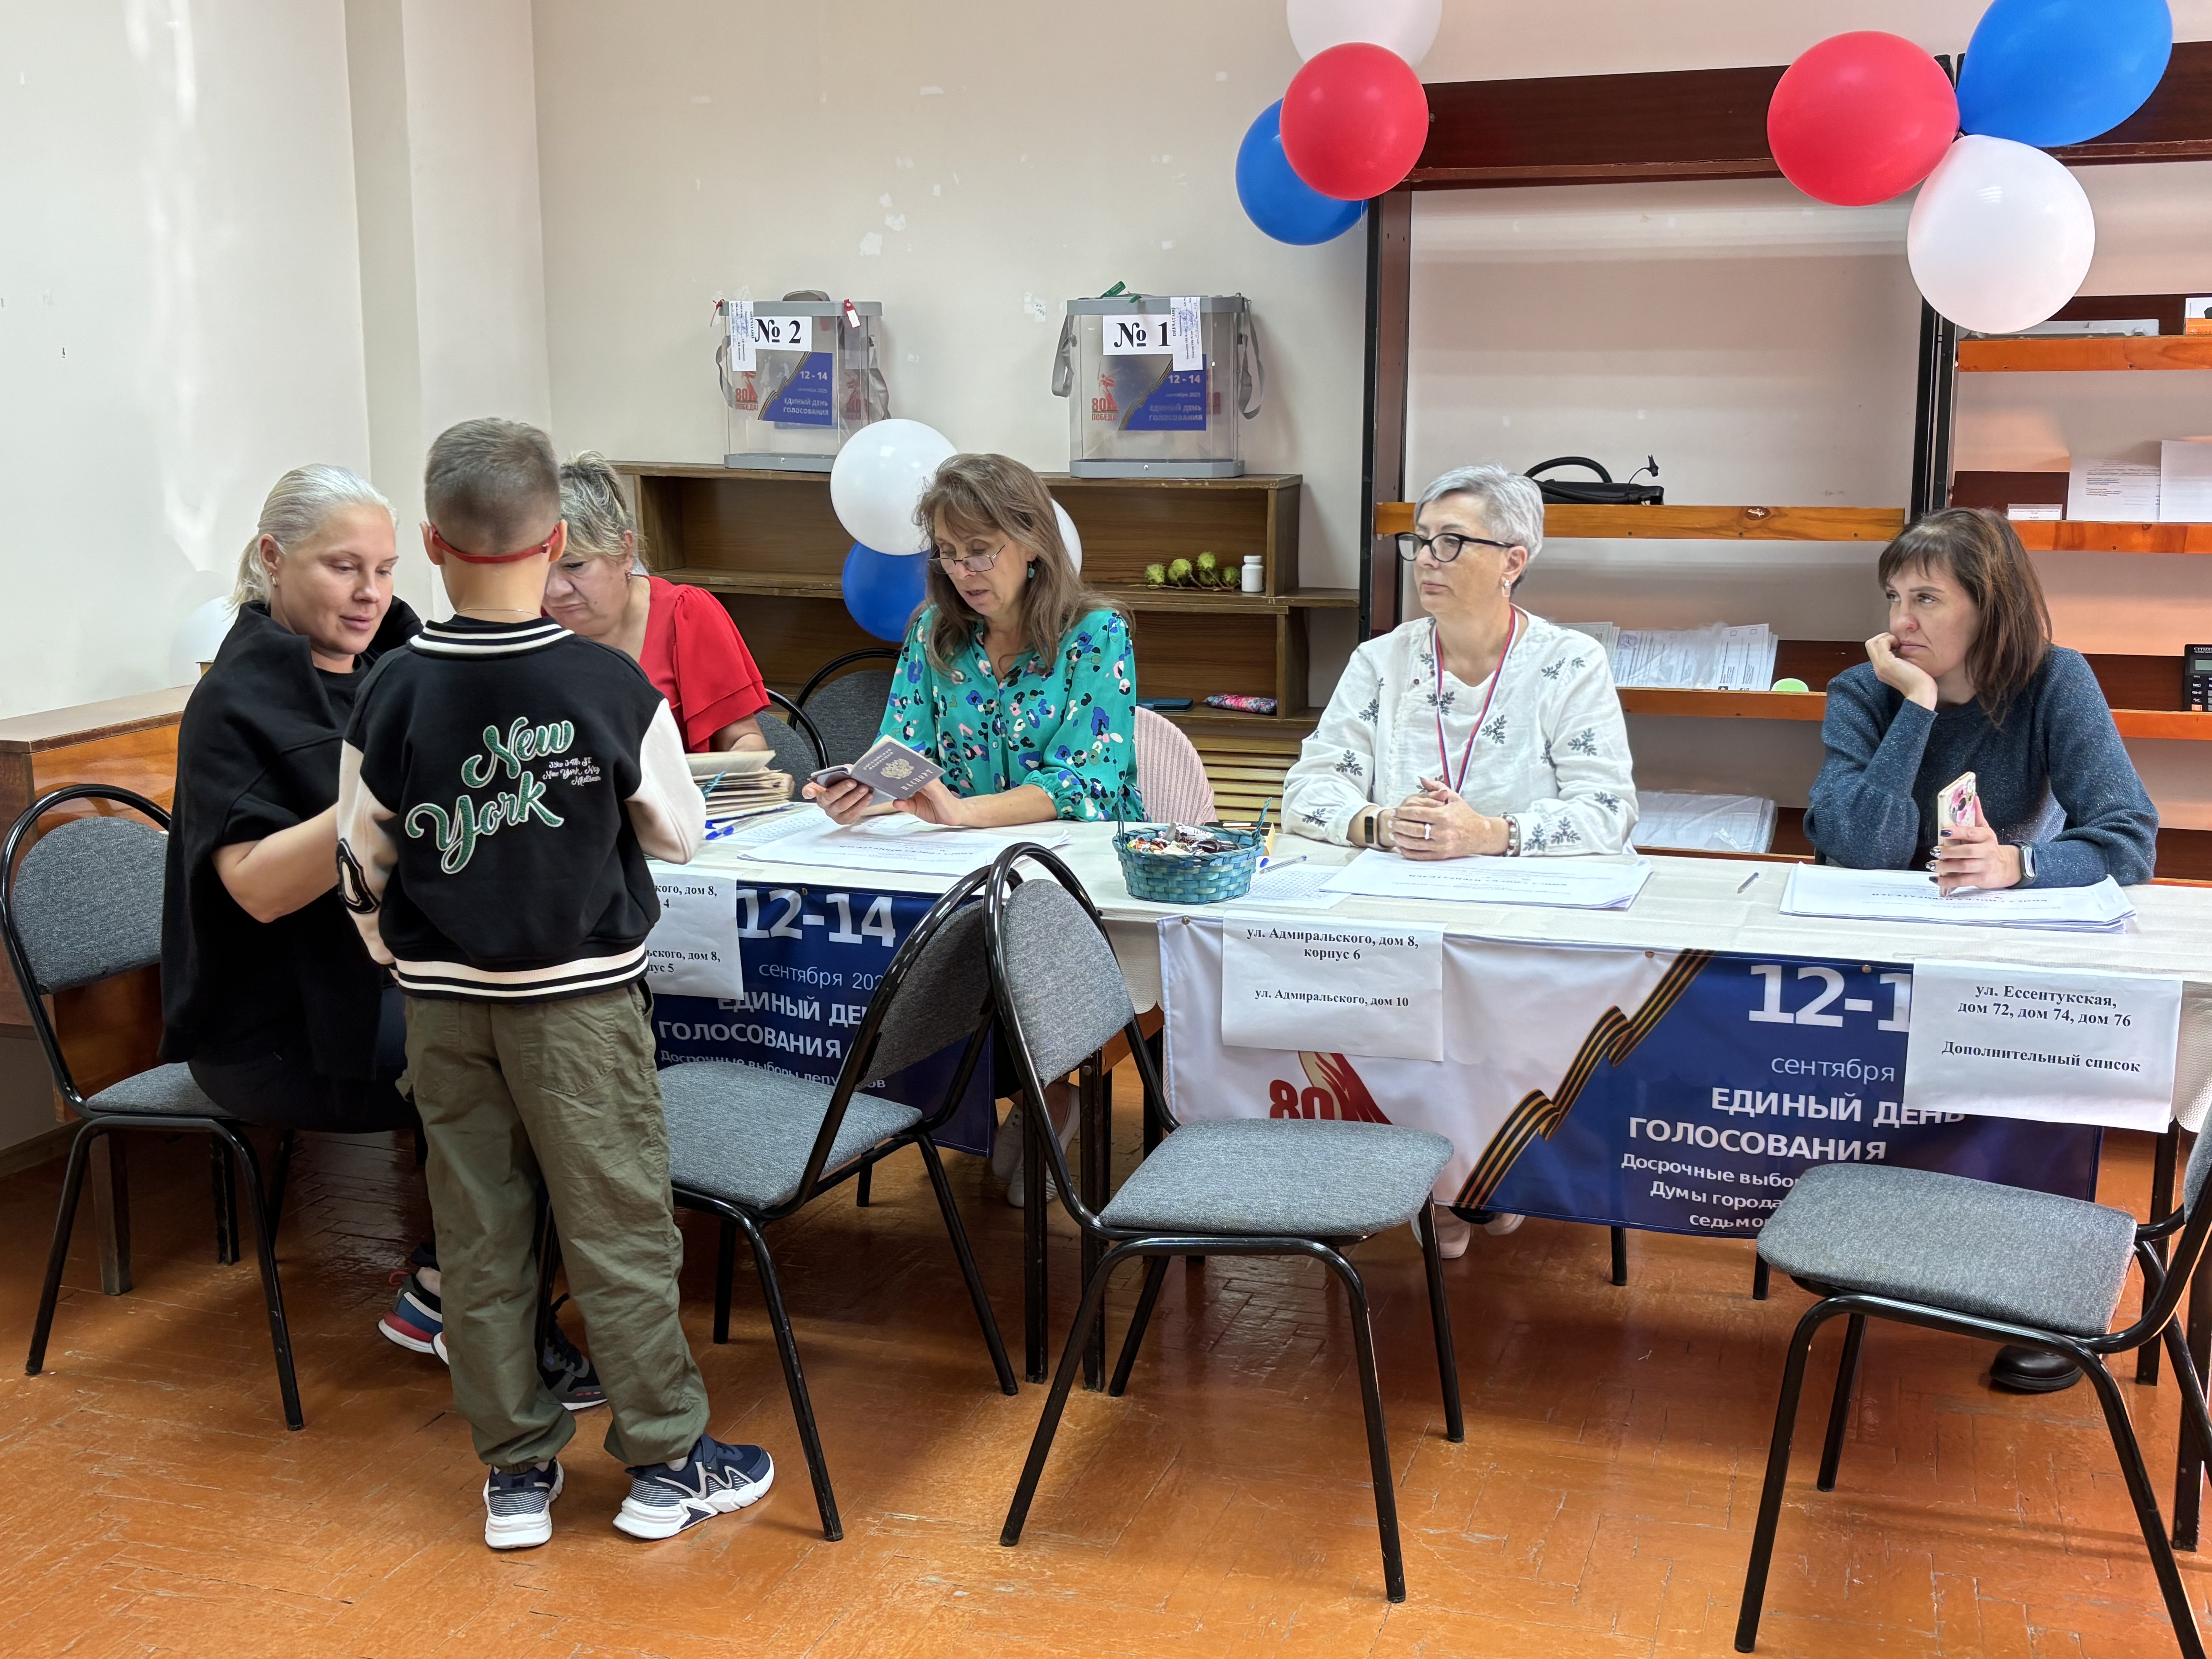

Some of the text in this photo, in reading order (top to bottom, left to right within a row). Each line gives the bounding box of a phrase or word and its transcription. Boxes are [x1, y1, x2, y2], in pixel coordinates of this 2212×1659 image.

[755, 319, 801, 343] № 2
[1114, 322, 1171, 347] № 1
[800, 371, 810, 379] 12
[817, 372, 828, 380] 14
[1168, 374, 1180, 383] 12
[1188, 374, 1200, 383] 14
[783, 407, 829, 416] ГОЛОСОВАНИЯ
[784, 398, 811, 406] ЕДИНЫЙ
[1092, 398, 1108, 411] 80
[1149, 403, 1181, 412] ЕДИНЫЙ
[461, 716, 575, 788] New
[900, 769, 934, 791] ПАСПОРТ
[405, 771, 565, 874] York
[663, 898, 670, 908] 4
[684, 886, 705, 895] дом
[708, 886, 717, 898] 8,
[737, 888, 896, 948] 12-14
[1247, 927, 1419, 949] ул. Адмиральского, дом 8,
[688, 952, 708, 960] дом
[711, 951, 721, 962] 8,
[1304, 948, 1360, 961] корпус 6
[668, 963, 674, 973] 5
[759, 964, 843, 989] сентября
[1255, 989, 1409, 1007] ул. Адмиральского, дом 10
[1975, 986, 2117, 1009] ул. Ессентукская,
[828, 1004, 867, 1028] ДЕ
[1958, 1003, 2131, 1027] дом 72, дом 74, дом 76
[658, 1021, 842, 1059] ГОЛОСОВАНИЯ
[1941, 1041, 2141, 1072] Дополнительный список
[1771, 1058, 1895, 1085] сентября
[1711, 1087, 1862, 1123] ЕДИНЫЙ
[1629, 1117, 1887, 1161] ГОЛОСОВАНИЯ
[1621, 1153, 1799, 1188] Досрочные выбо
[1650, 1181, 1782, 1211] Думы города
[1689, 1214, 1768, 1230] седьмо
